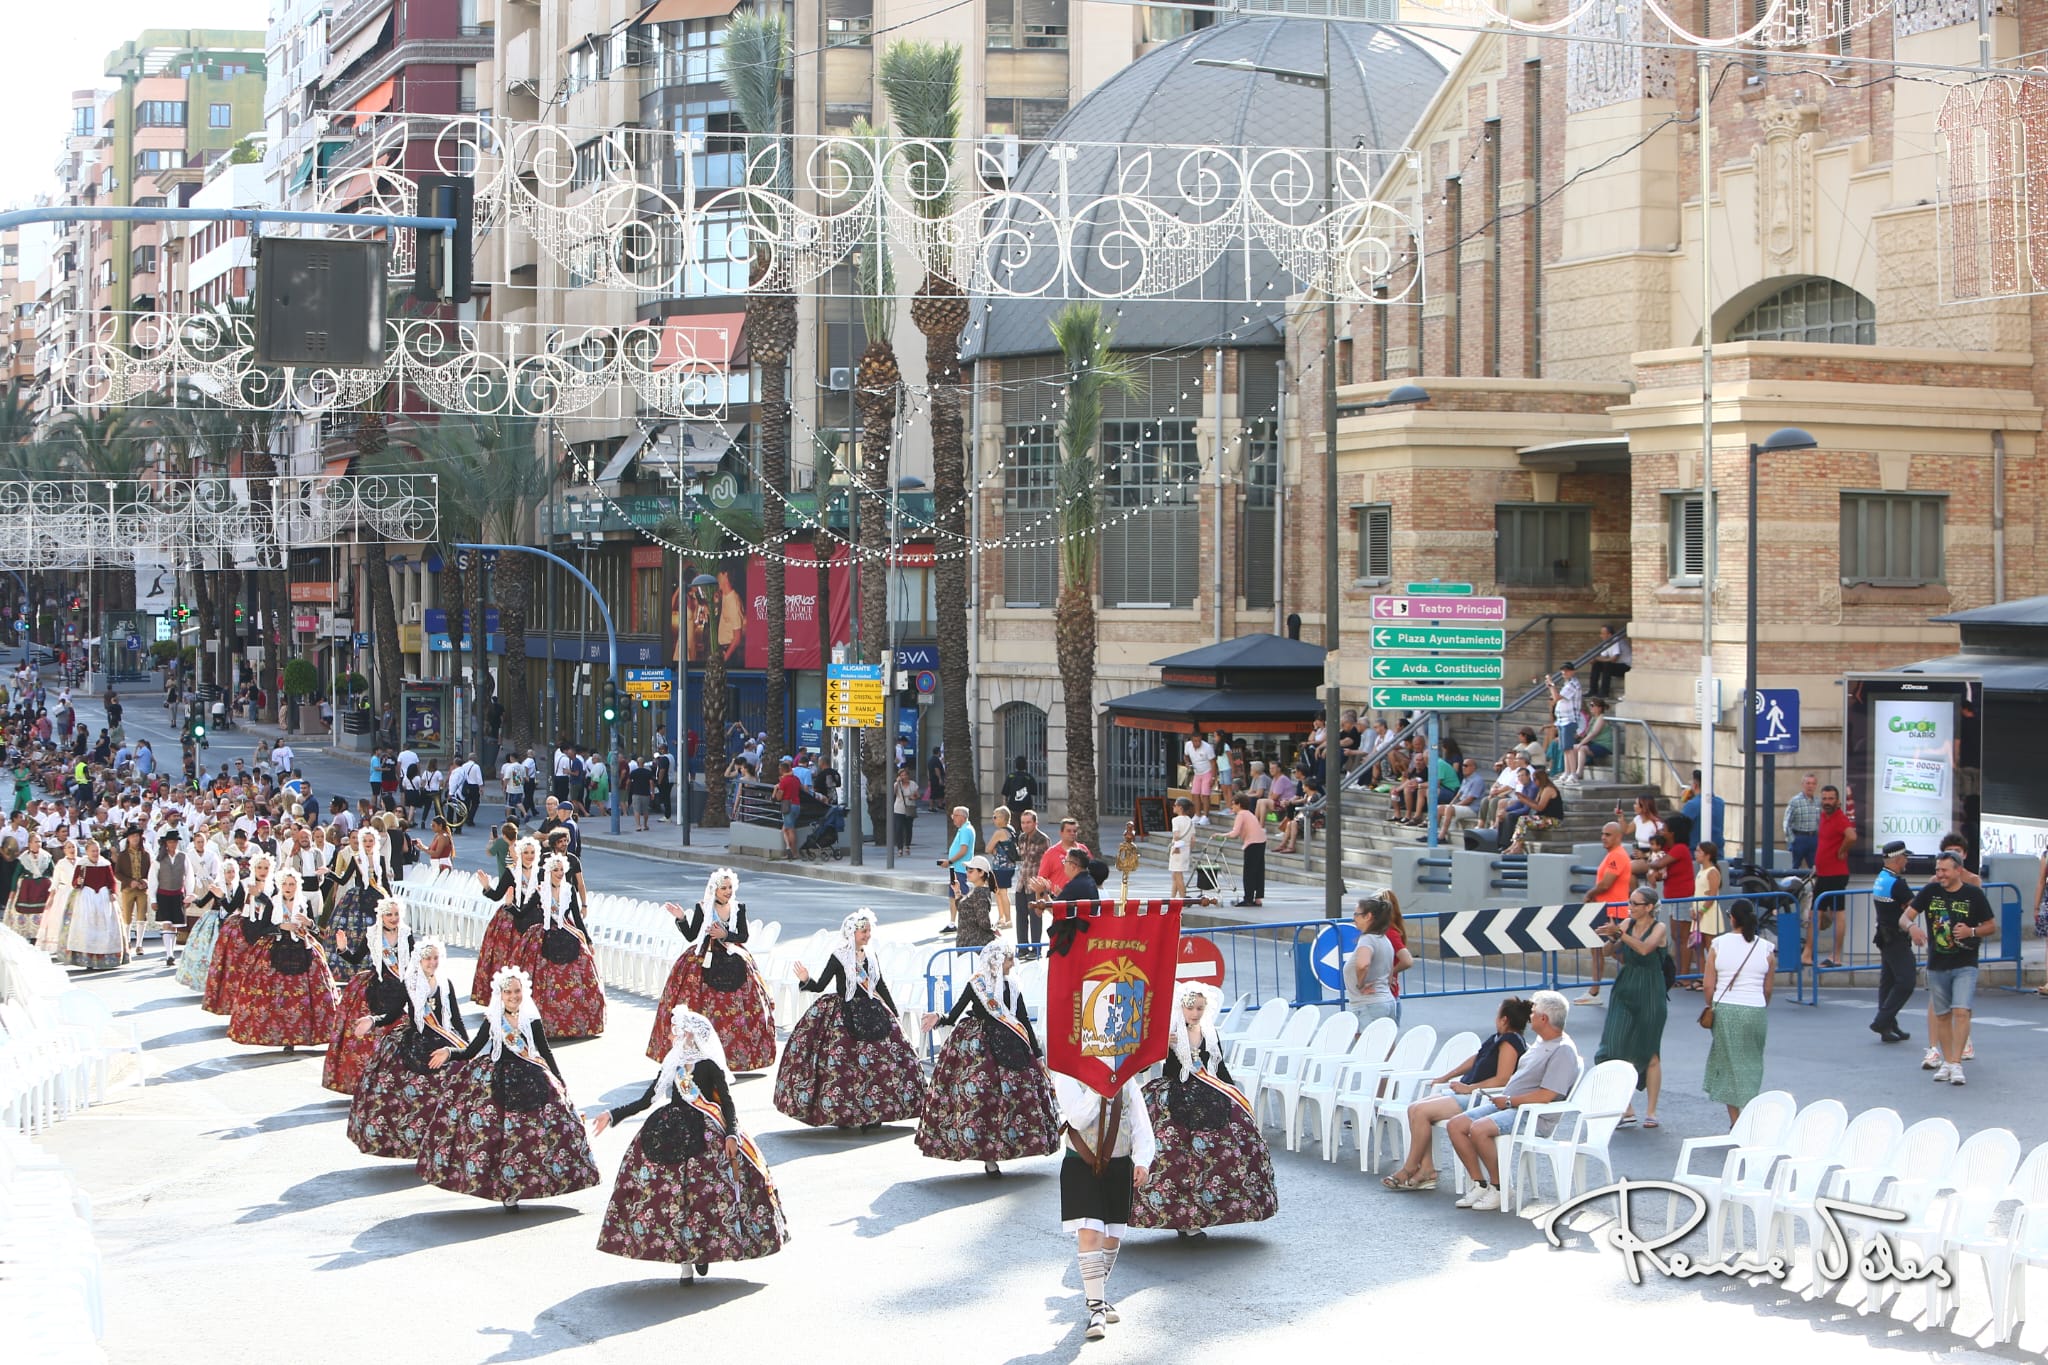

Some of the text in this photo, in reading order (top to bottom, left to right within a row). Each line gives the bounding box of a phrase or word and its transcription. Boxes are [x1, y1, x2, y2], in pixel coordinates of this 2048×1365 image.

[1419, 603, 1501, 615] Teatro Principal
[1398, 633, 1501, 646] Plaza Ayuntamiento
[1402, 664, 1500, 673] Avda. Constitución
[1401, 692, 1500, 702] Rambla Méndez Núñez
[1908, 731, 1936, 739] DIARIO
